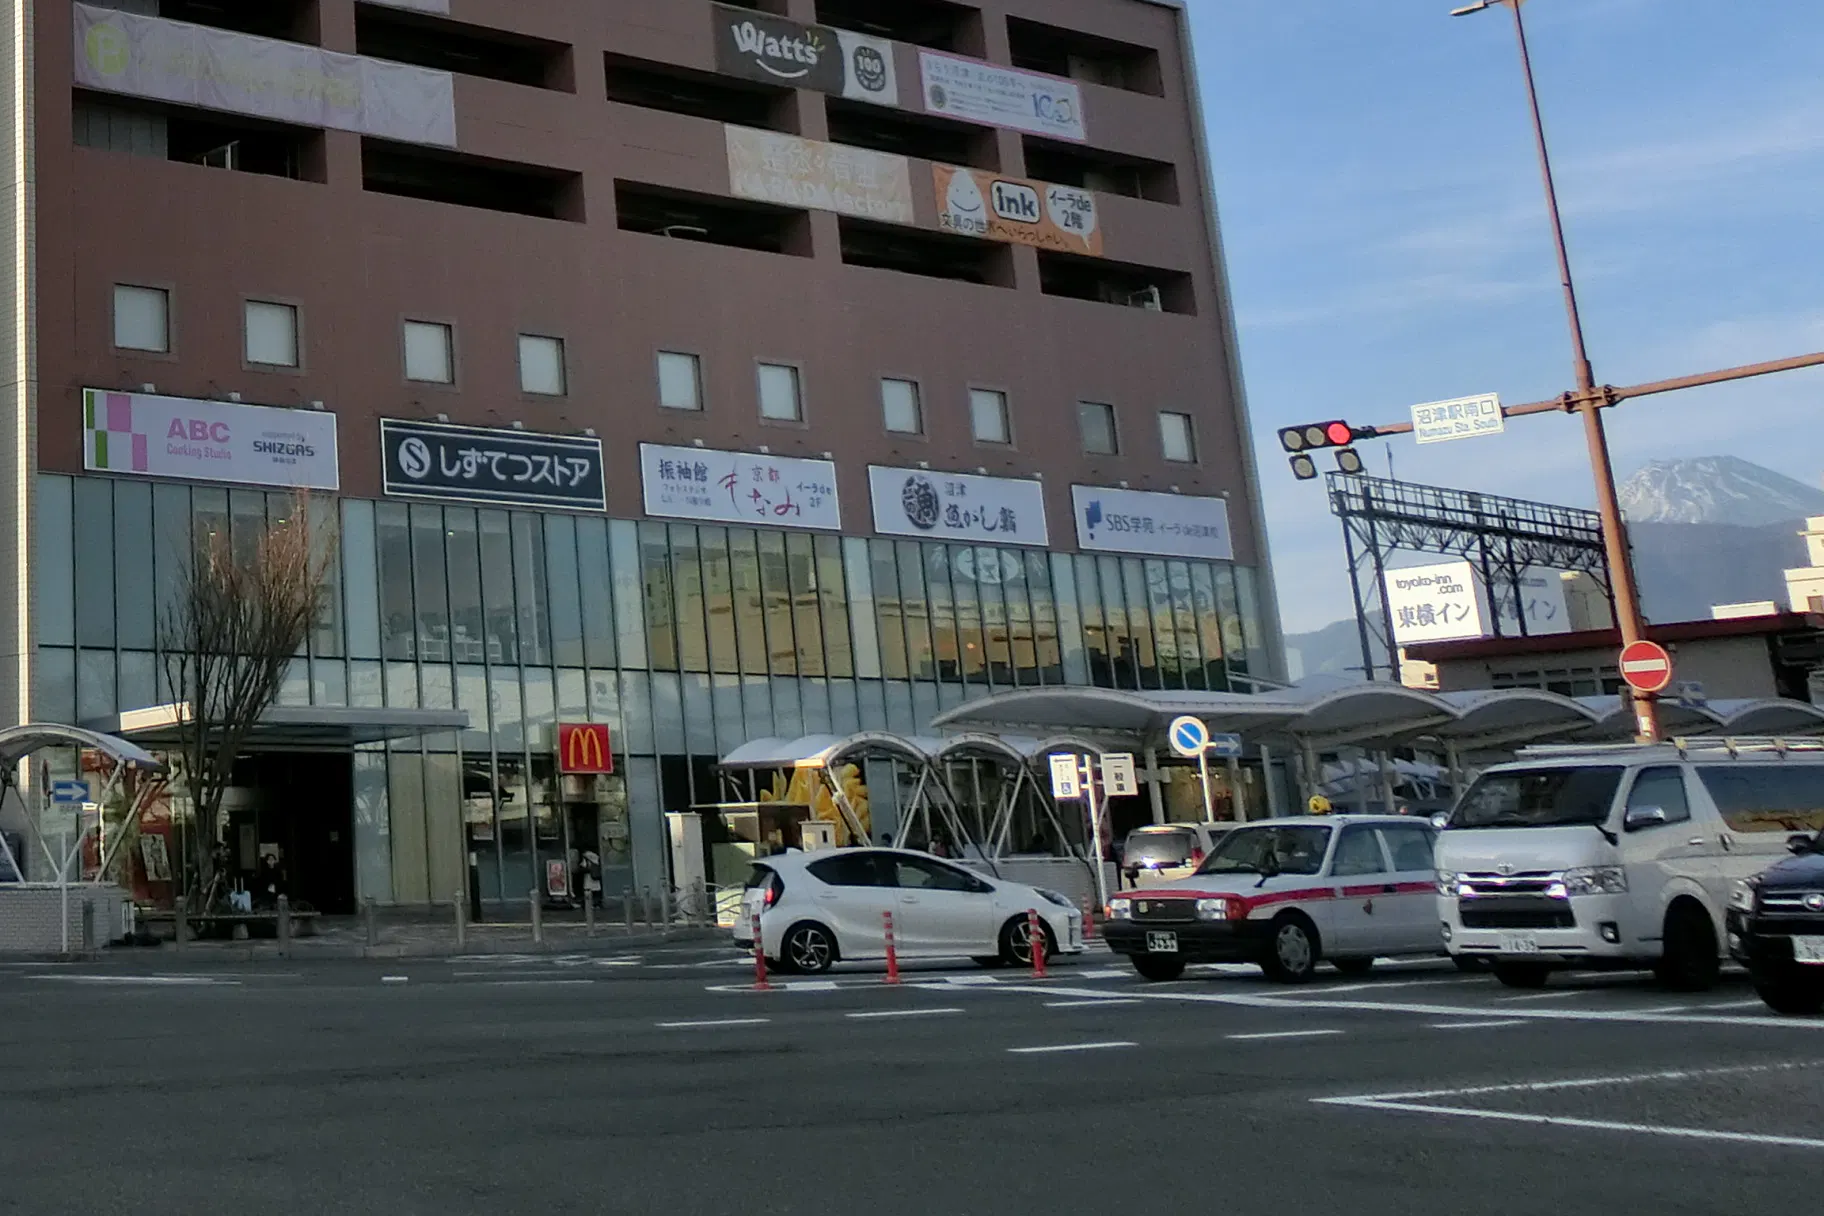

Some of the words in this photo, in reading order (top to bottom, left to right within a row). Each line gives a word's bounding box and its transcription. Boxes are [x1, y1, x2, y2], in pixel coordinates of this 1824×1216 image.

[730, 21, 818, 65] Watts
[996, 185, 1036, 217] ink
[1416, 399, 1496, 425] 沼津駅南口
[166, 417, 232, 444] ABC
[166, 443, 202, 460] Cooking
[203, 445, 232, 461] Studio
[252, 440, 316, 458] SHIZGAS
[439, 444, 591, 487] しずてつストア
[658, 458, 709, 482] 振袖館
[751, 464, 780, 483] 京都
[1105, 513, 1155, 534] SBS学苑
[1395, 573, 1453, 591] toyoko-inn
[1437, 583, 1464, 596] .com
[1397, 602, 1470, 629] 東横イン
